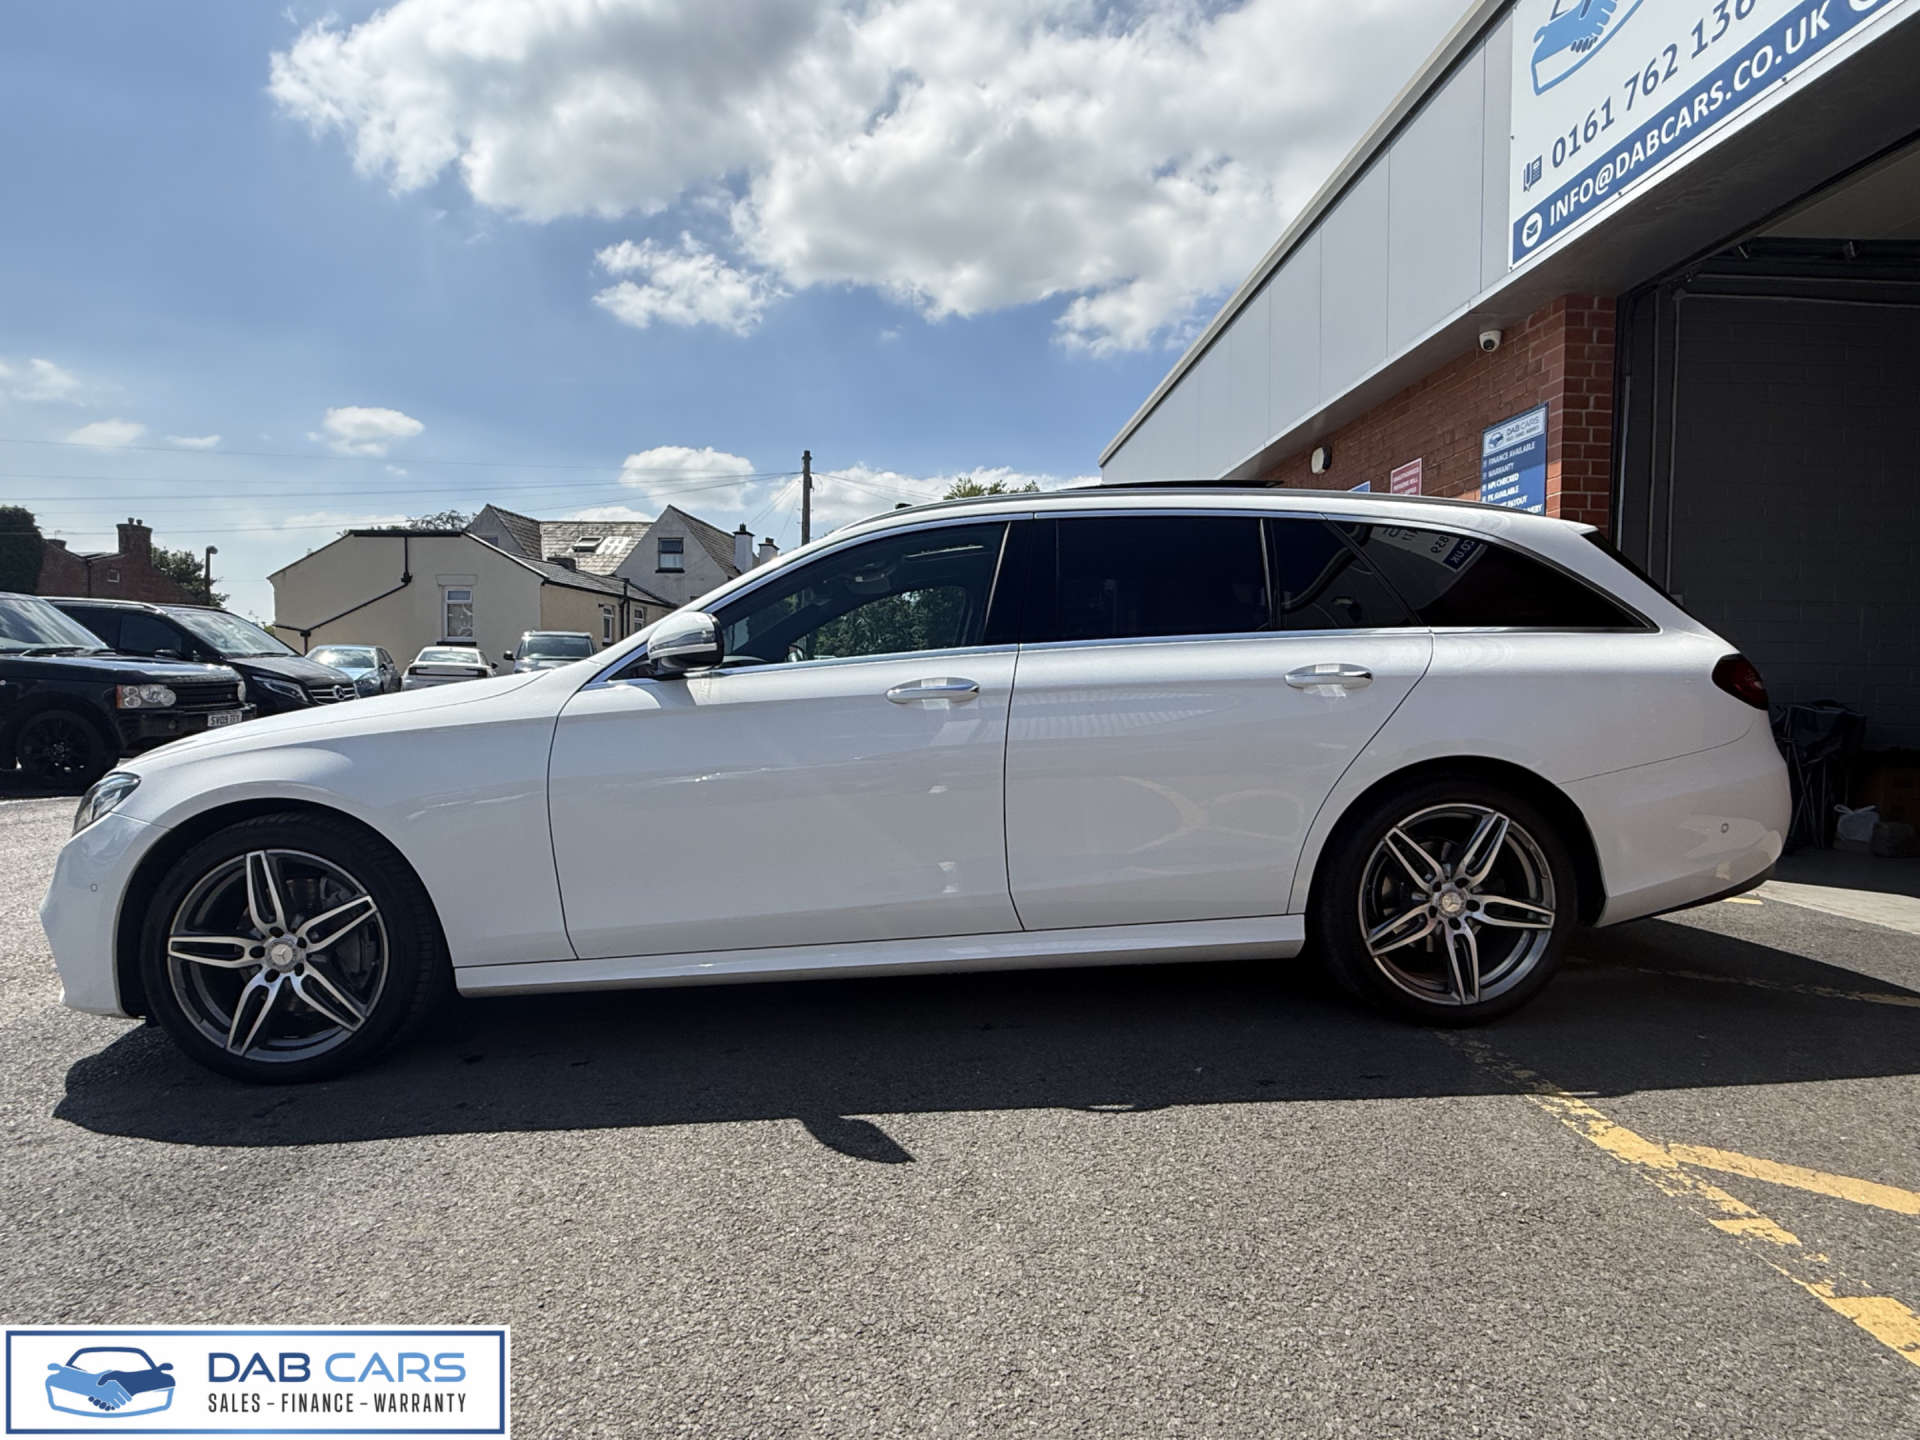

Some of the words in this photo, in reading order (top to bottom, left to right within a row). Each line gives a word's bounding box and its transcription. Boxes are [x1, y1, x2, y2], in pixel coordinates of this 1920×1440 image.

[1550, 1, 1831, 226] INFO@DABCARS.CO.UK
[1552, 96, 1615, 168] 0161
[1624, 43, 1678, 111] 762
[1506, 424, 1520, 436] DAB
